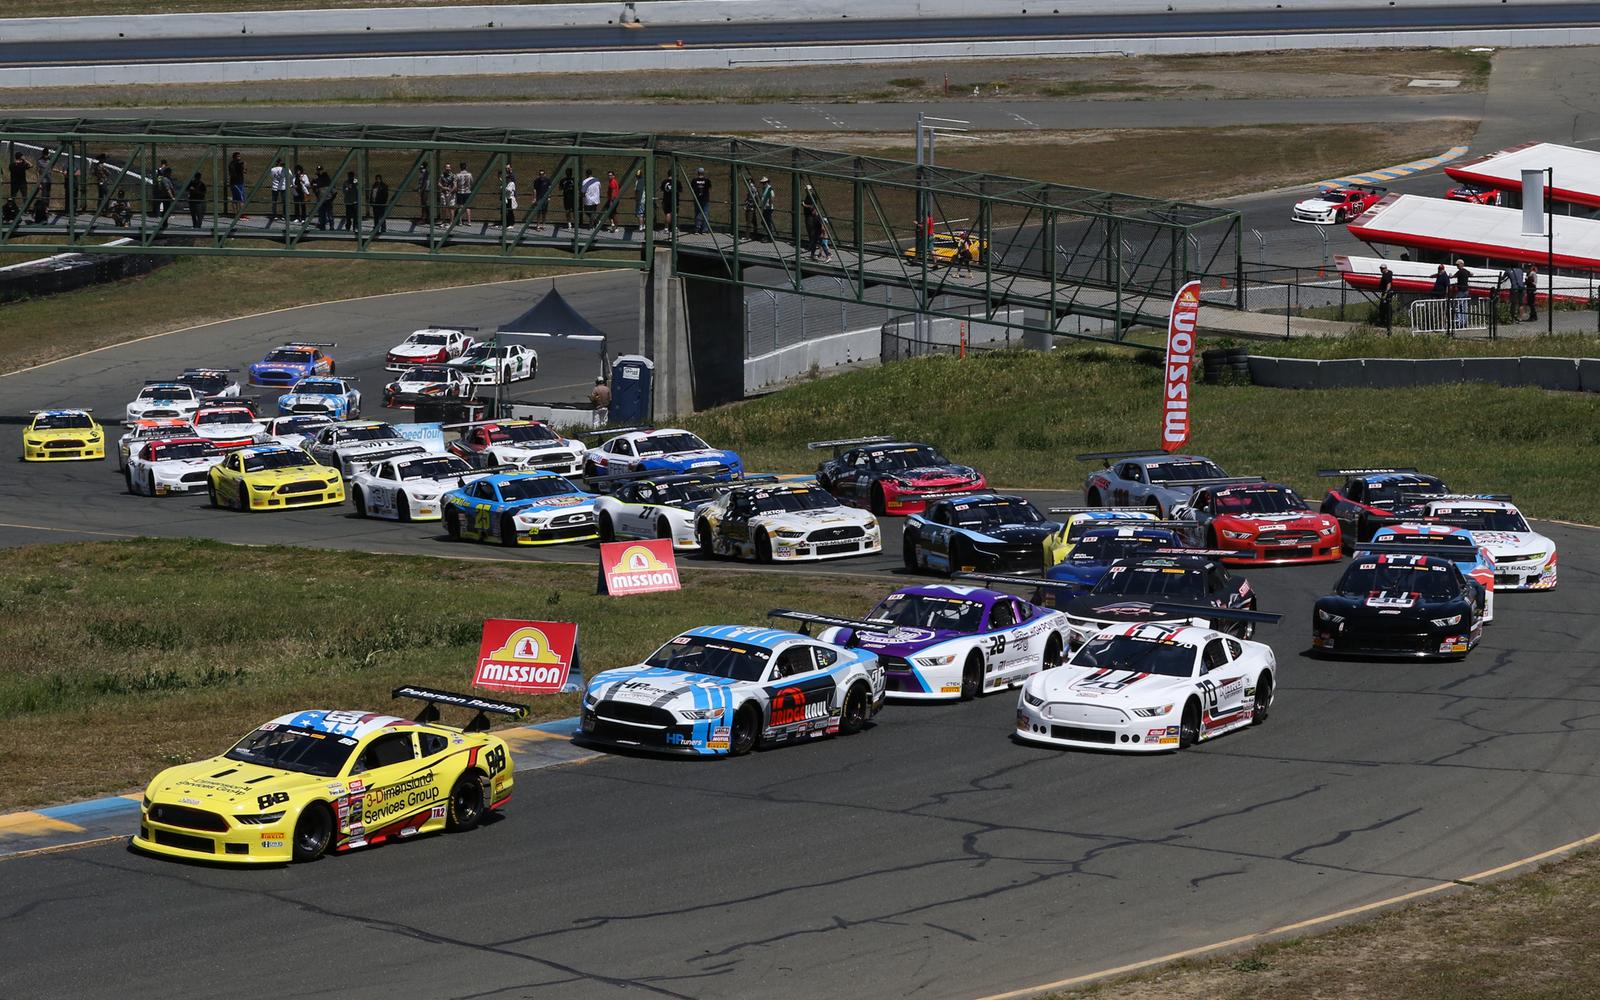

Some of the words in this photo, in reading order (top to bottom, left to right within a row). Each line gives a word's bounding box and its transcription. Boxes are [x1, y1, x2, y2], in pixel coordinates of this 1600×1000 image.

[1164, 311, 1196, 443] MISSION
[611, 573, 674, 588] MISSION
[989, 634, 1006, 656] 28
[482, 663, 561, 684] MISSION
[400, 687, 466, 703] Peterson
[468, 698, 520, 713] Racing
[484, 744, 506, 779] 88
[366, 769, 435, 808] 3-Dimensional
[257, 792, 290, 810] 88
[364, 800, 406, 825] Services
[407, 786, 441, 807] Group
[432, 808, 445, 820] TA2
